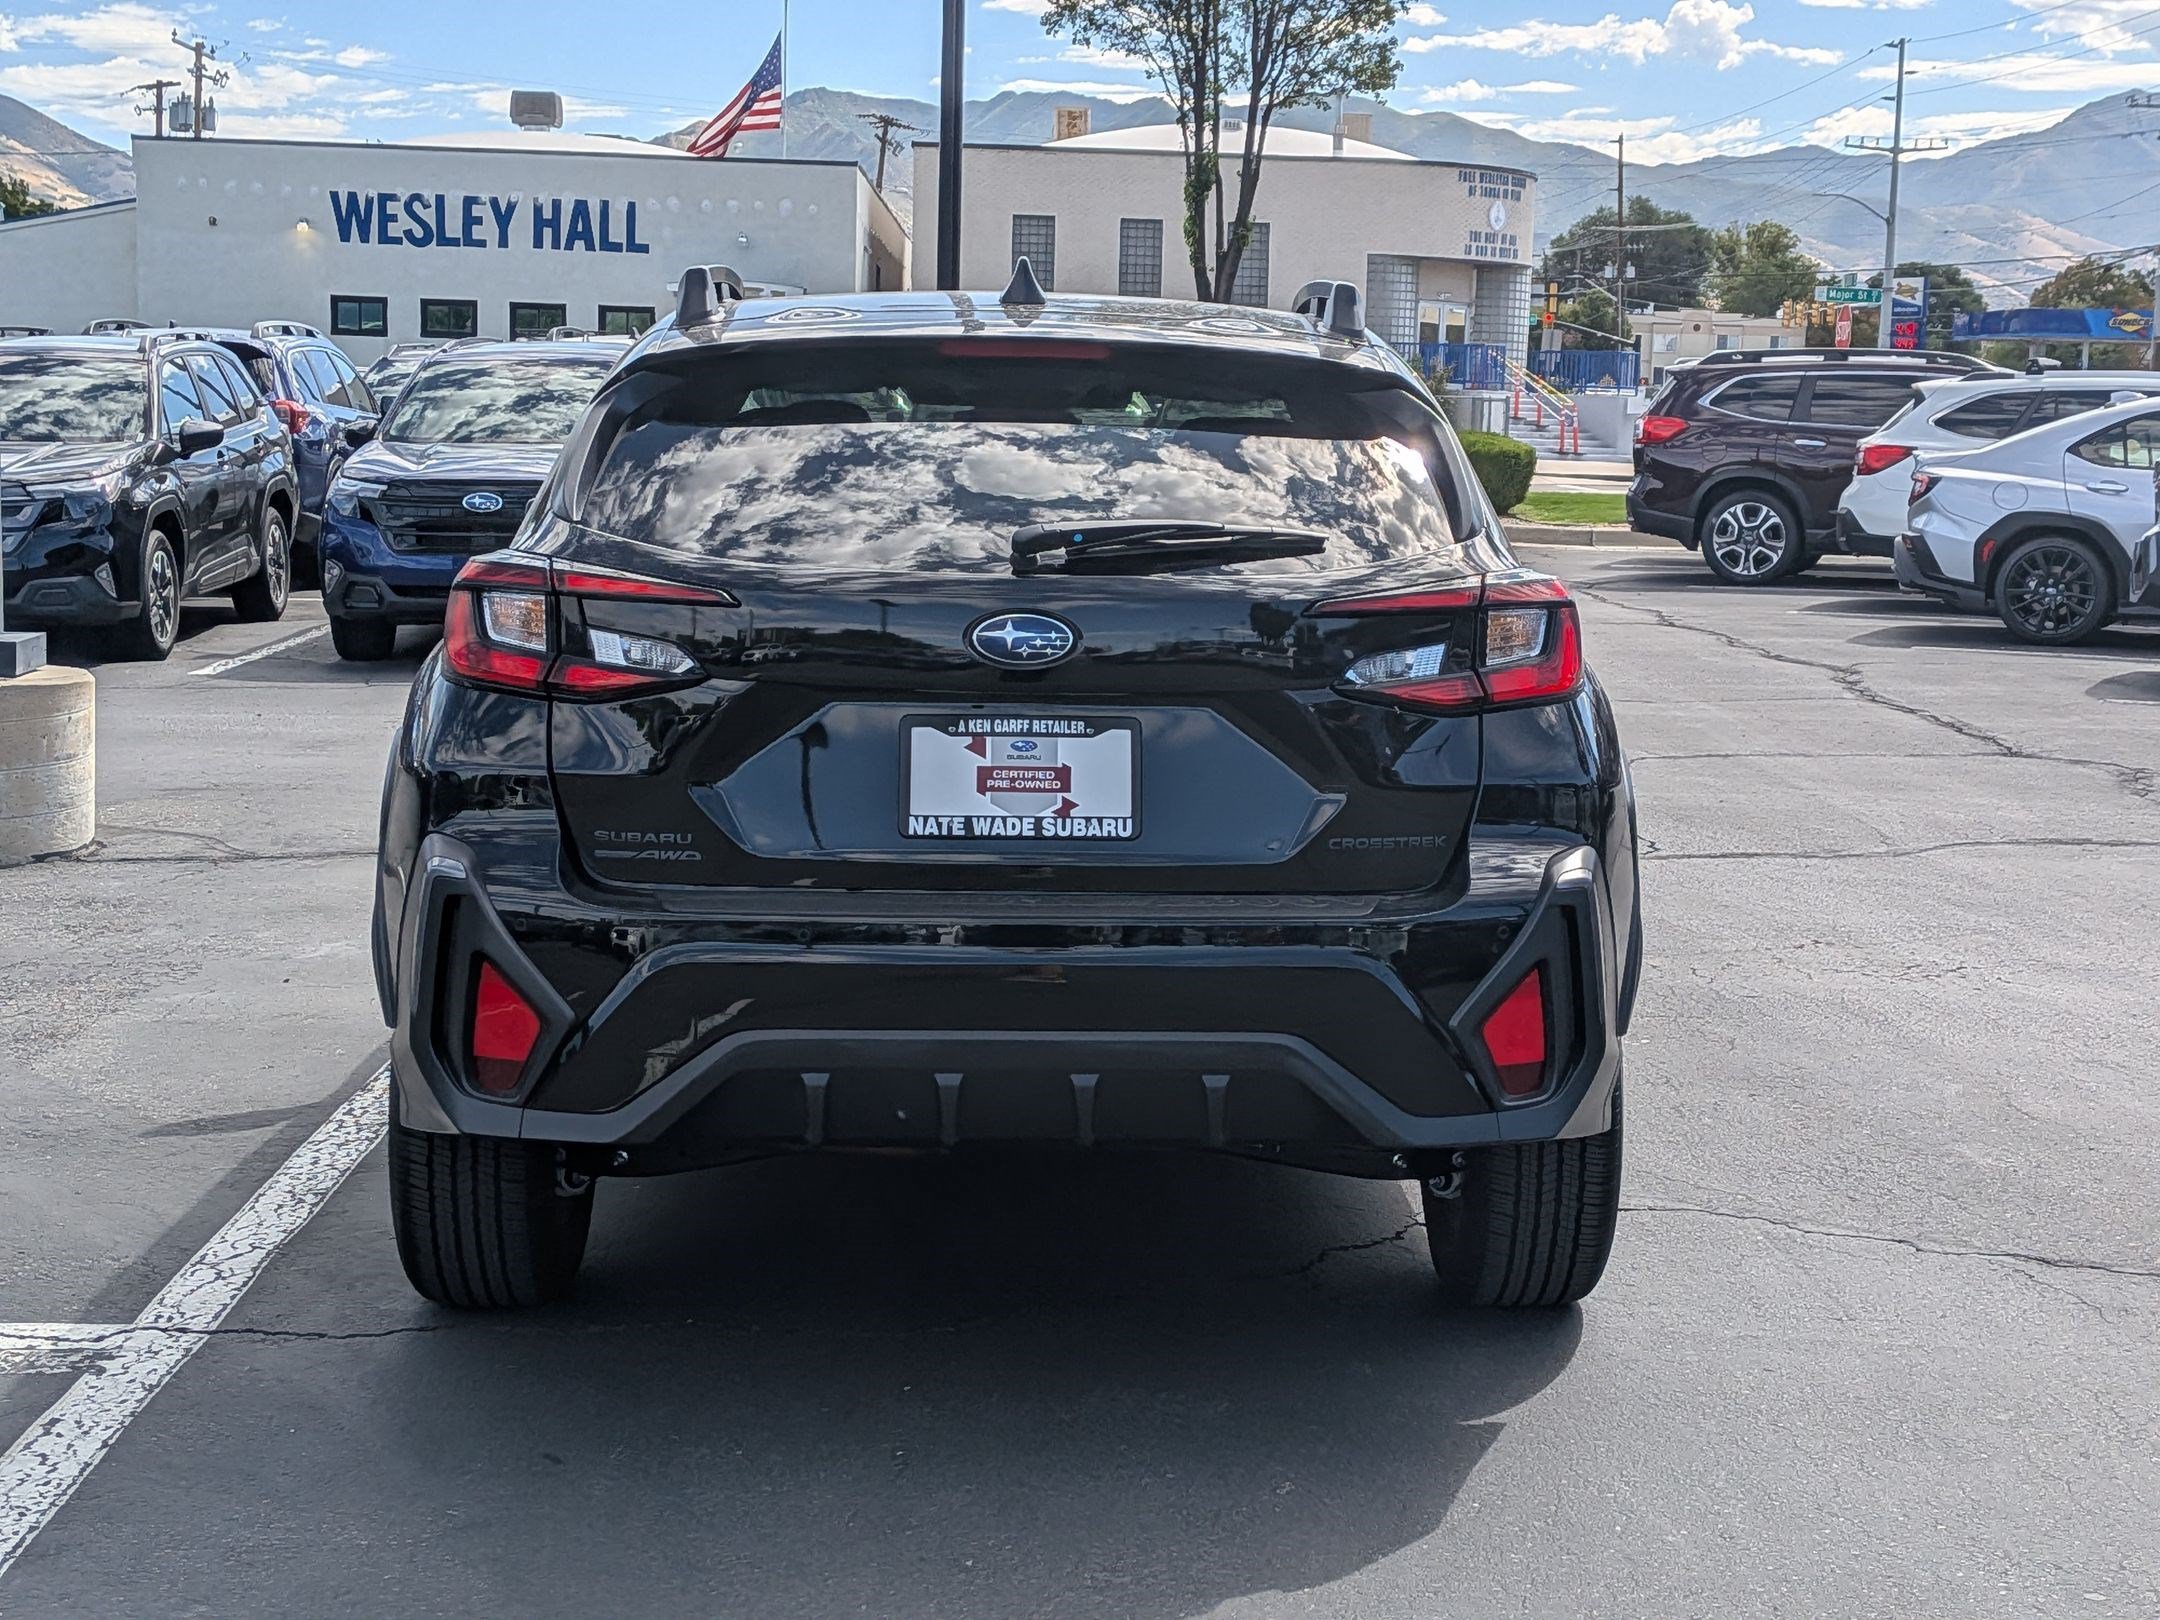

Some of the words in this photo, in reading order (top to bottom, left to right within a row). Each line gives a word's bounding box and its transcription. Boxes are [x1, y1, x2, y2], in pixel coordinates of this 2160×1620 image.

[329, 190, 520, 248] WESLEY
[532, 196, 650, 254] HALL
[1828, 289, 1854, 302] Major
[957, 720, 966, 733] A
[969, 719, 991, 733] KEN
[994, 720, 1029, 734] GARFF
[1032, 720, 1085, 735] RETAILER
[992, 769, 1056, 780] CERTIFIED
[986, 779, 1062, 790] PRE-OWNED
[908, 816, 966, 836] NATE
[972, 817, 1036, 837] WADE
[1041, 817, 1133, 838] SUBARU
[593, 830, 692, 844] SUBARU
[1328, 835, 1448, 850] CROSSTREK
[634, 849, 702, 861] AWD
